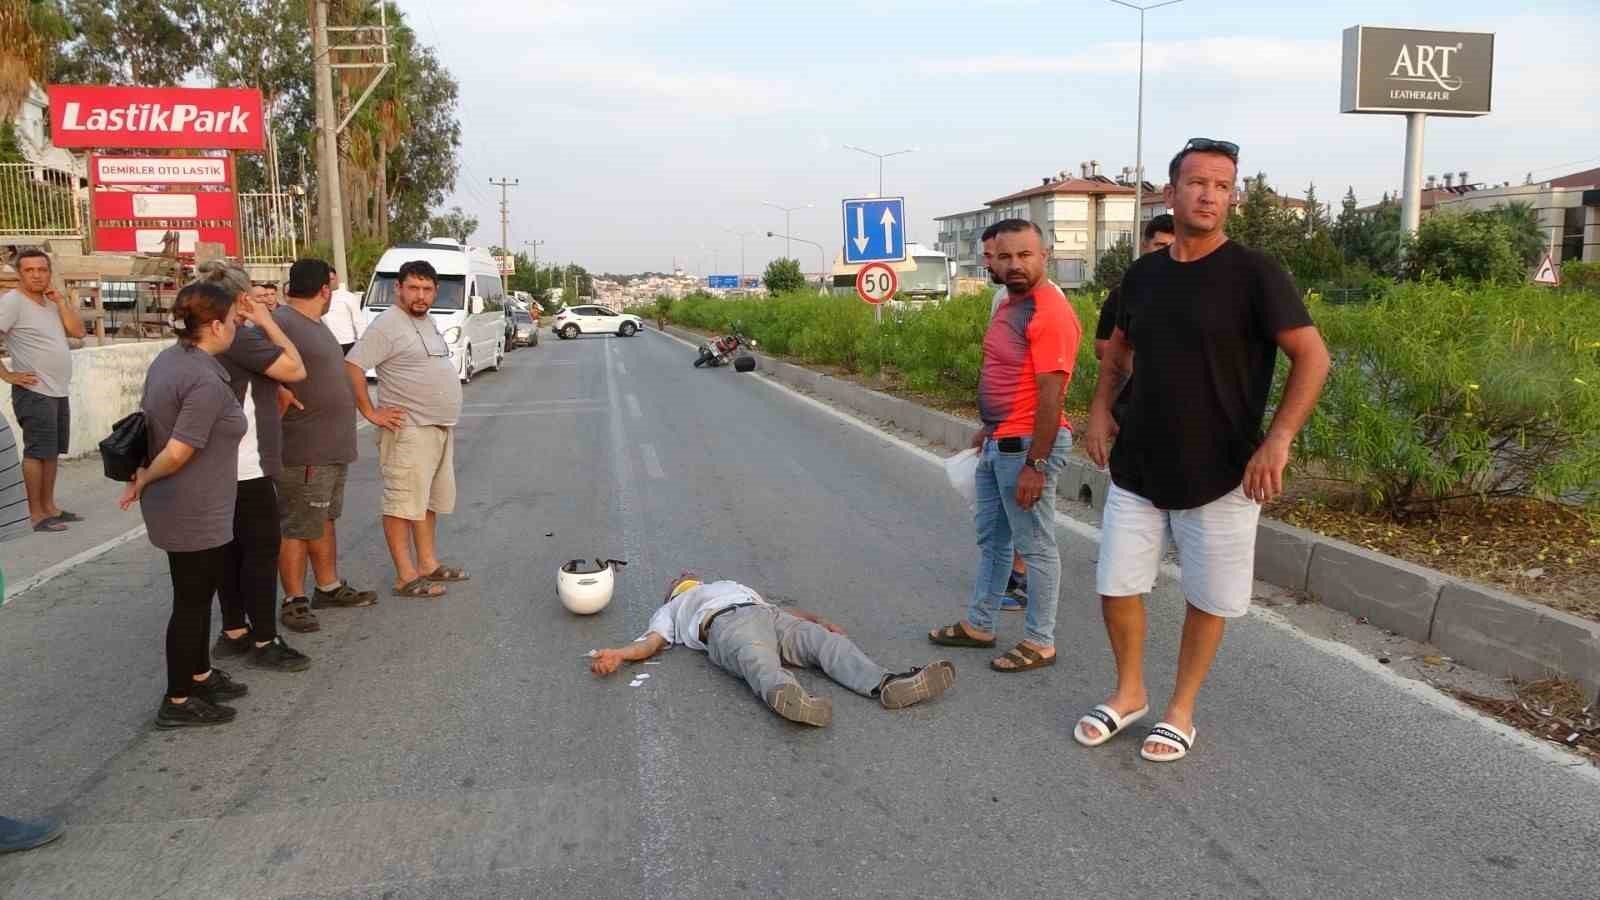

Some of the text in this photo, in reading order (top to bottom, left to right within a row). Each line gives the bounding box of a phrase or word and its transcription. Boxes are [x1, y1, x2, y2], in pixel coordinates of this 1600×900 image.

[1389, 44, 1462, 91] ART
[158, 165, 180, 175] OTO
[865, 273, 890, 292] 50
